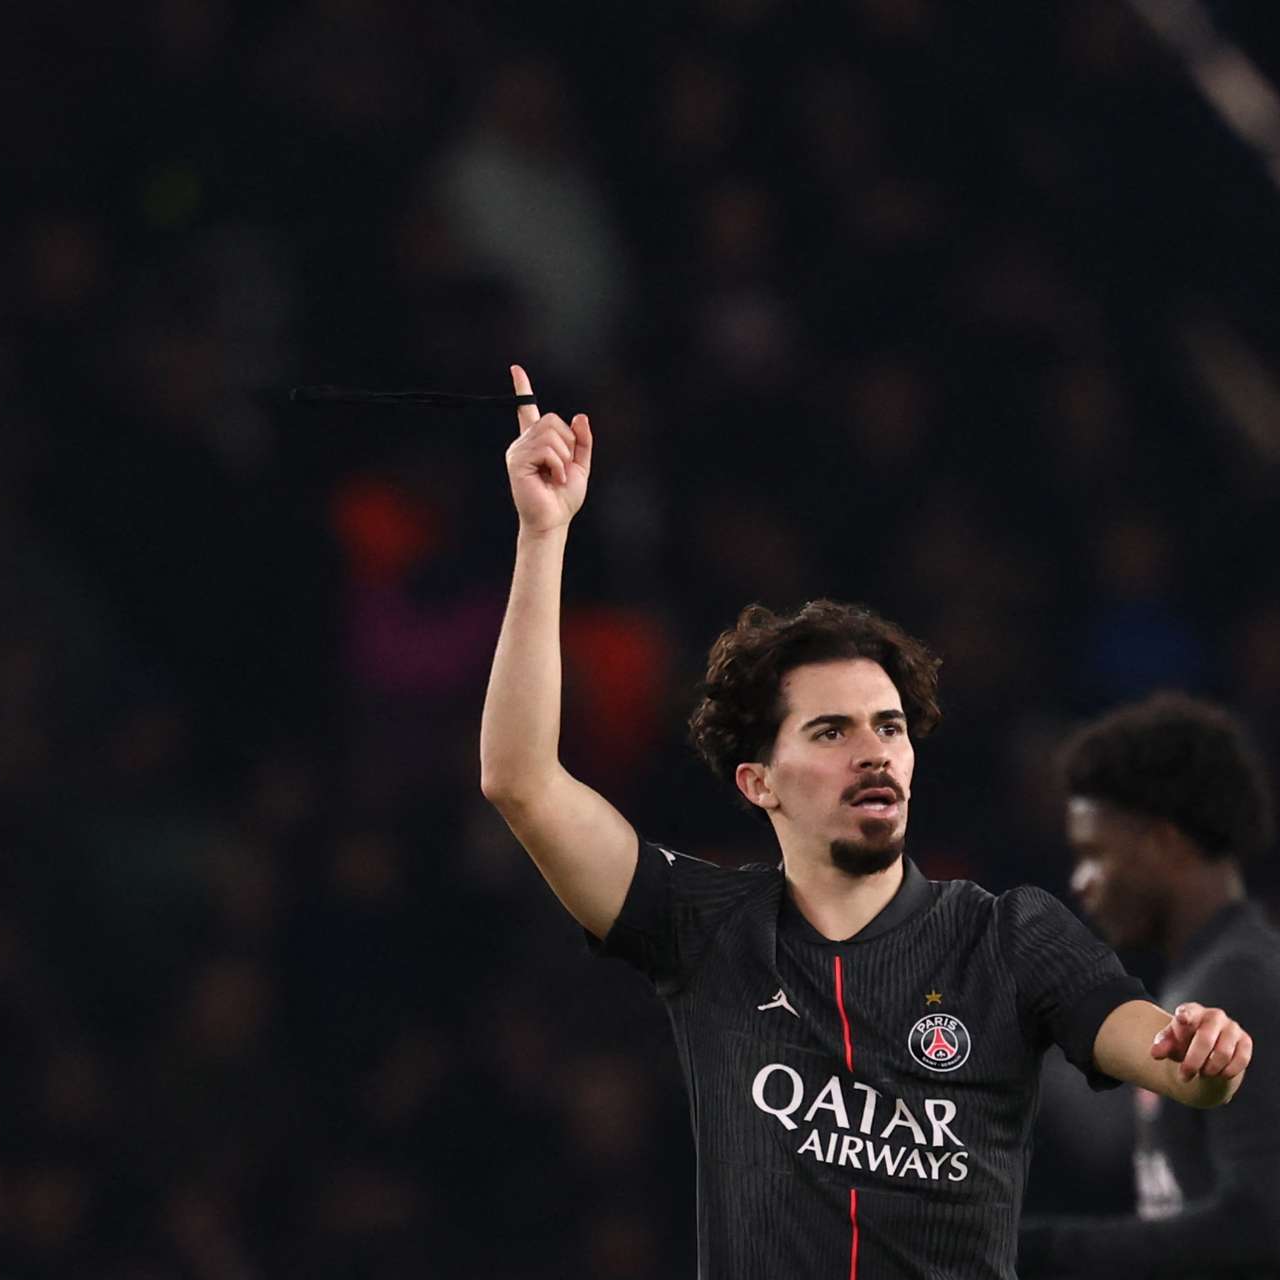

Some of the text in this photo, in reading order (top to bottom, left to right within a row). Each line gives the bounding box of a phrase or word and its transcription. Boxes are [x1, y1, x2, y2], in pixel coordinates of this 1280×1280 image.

[917, 1016, 958, 1033] PARIS
[751, 1063, 965, 1147] QATAR
[797, 1128, 969, 1181] AIRWAYS
